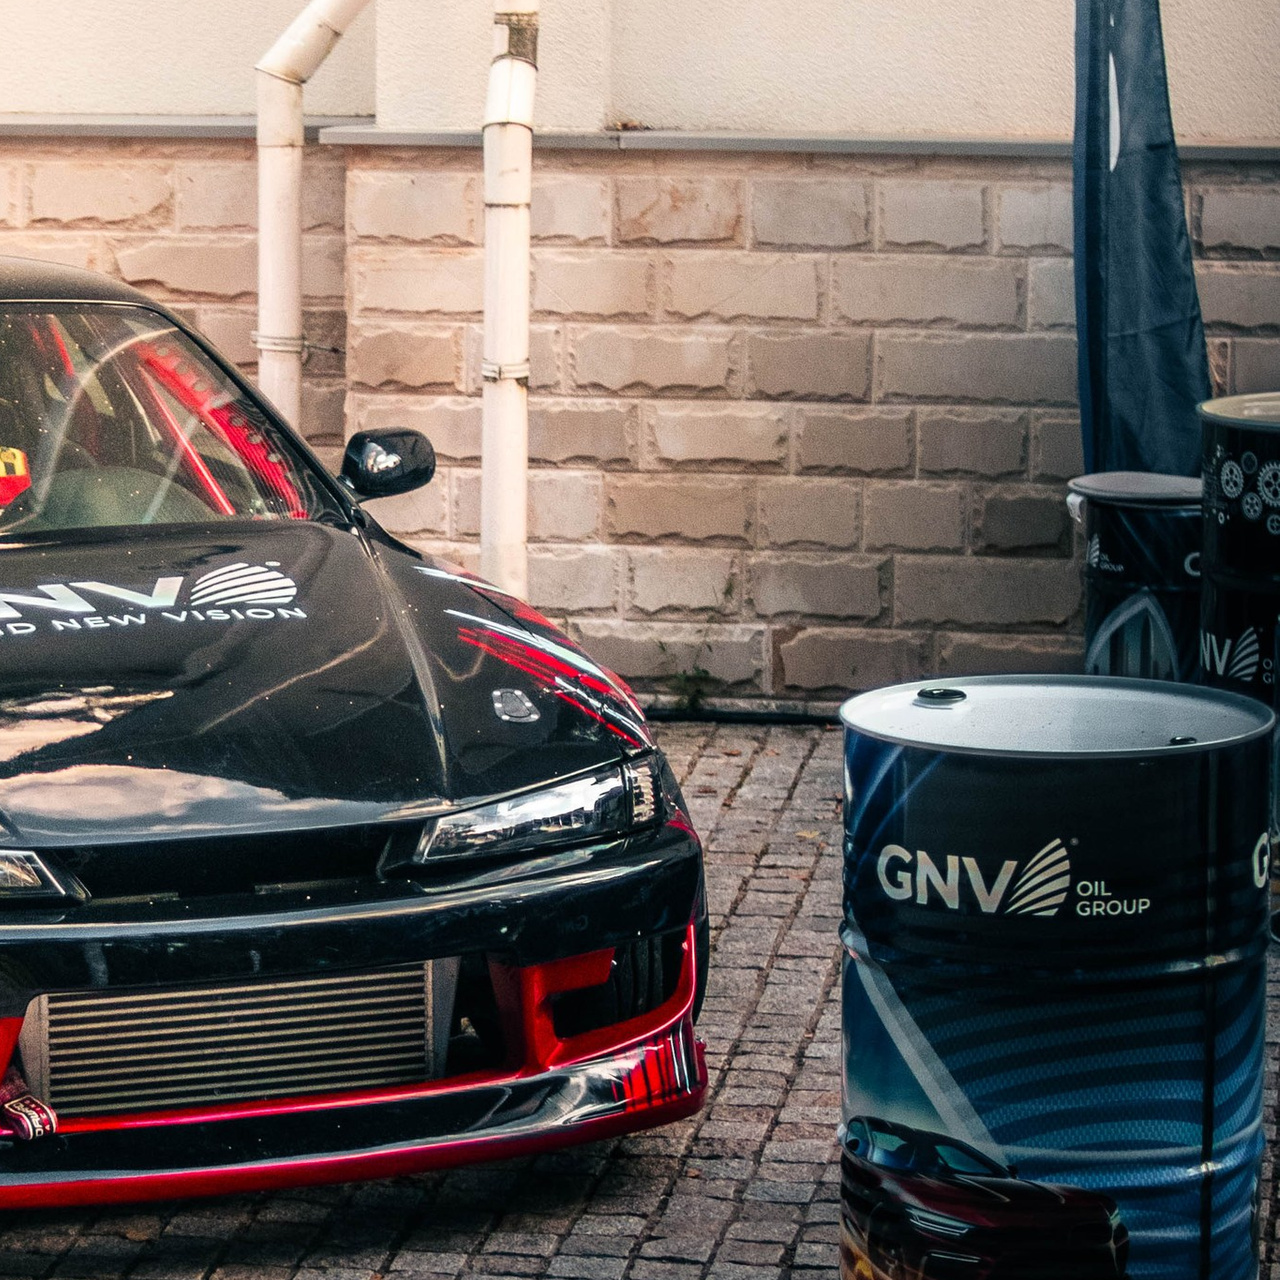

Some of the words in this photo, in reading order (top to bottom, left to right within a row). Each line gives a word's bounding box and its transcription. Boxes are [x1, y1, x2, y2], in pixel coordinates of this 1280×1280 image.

[52, 612, 148, 632] NEW
[161, 605, 309, 624] VISION
[1200, 627, 1233, 677] NV
[876, 844, 1018, 914] GNV
[1076, 880, 1112, 897] OIL
[1076, 898, 1151, 917] GROUP
